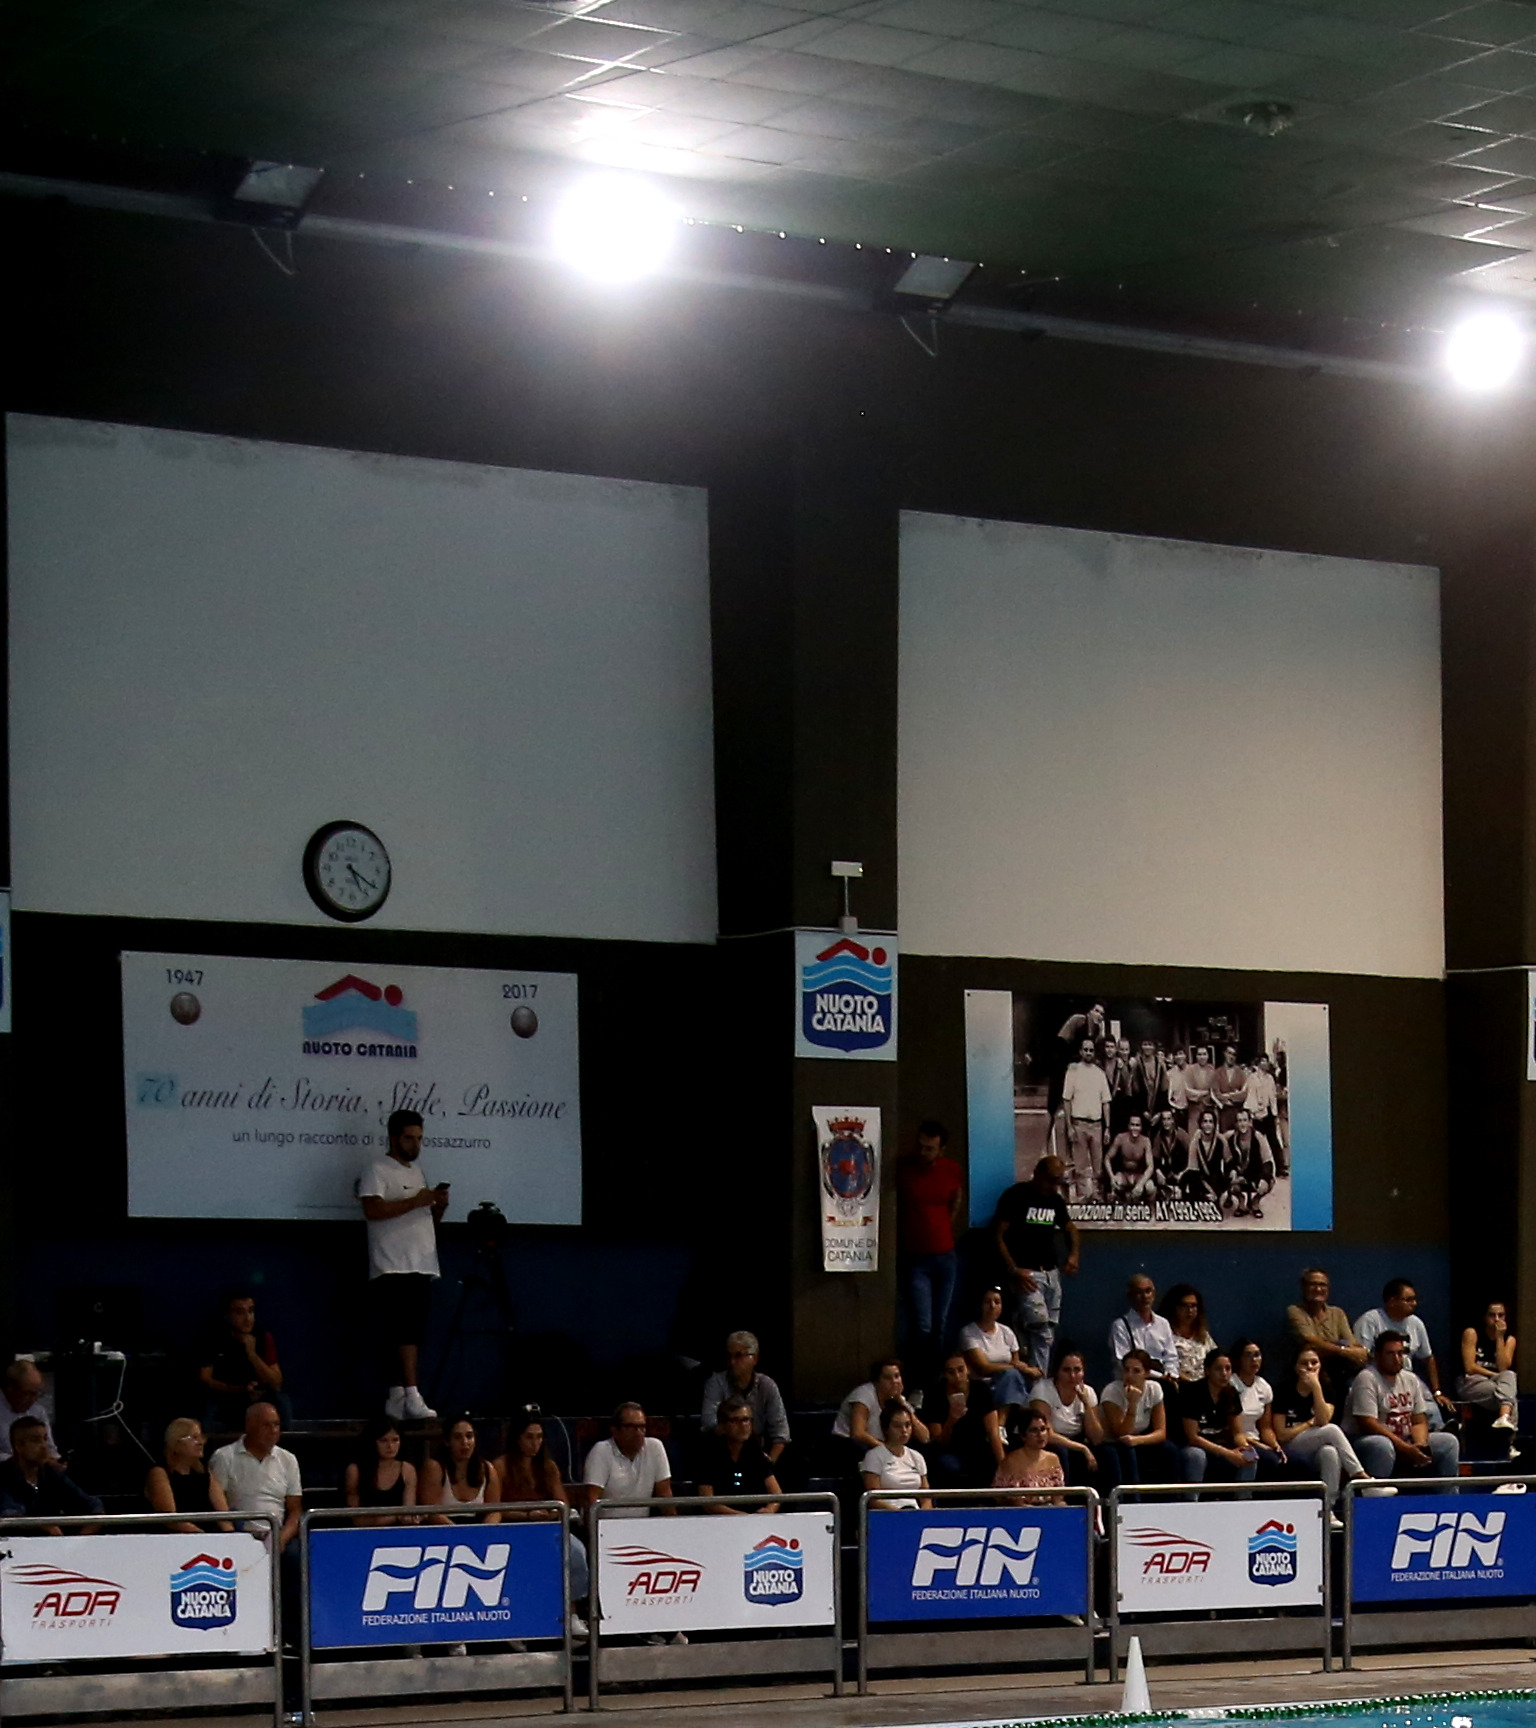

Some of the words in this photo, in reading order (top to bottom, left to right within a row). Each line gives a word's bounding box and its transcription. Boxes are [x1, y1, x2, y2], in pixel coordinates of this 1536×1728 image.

[165, 969, 204, 986] 1947
[503, 984, 538, 1000] 2017
[816, 993, 879, 1014] NUOTO
[811, 1013, 885, 1034] CATANIA
[302, 1041, 353, 1055] NUOTO
[357, 1042, 418, 1058] CATANIA
[181, 1083, 243, 1109] anni
[248, 1077, 277, 1110] di
[457, 1082, 567, 1119] Passione
[233, 1131, 250, 1143] un
[254, 1129, 295, 1147] lungo
[298, 1131, 359, 1146] racconto
[361, 1133, 374, 1146] di
[422, 1136, 491, 1149] ossazzurro
[1113, 1200, 1124, 1221] in
[1125, 1201, 1151, 1221] serie
[827, 1250, 873, 1261] CATANIA
[1391, 1511, 1506, 1569] FIN
[911, 1526, 1042, 1587] FIN
[1143, 1551, 1211, 1575] ADR
[1255, 1552, 1291, 1565] NUOTO
[361, 1543, 511, 1612] FIN
[752, 1569, 795, 1583] NUOTO
[1252, 1563, 1294, 1577] CATANIA
[1391, 1571, 1441, 1582] FEDERAZIONE
[1442, 1570, 1475, 1580] ITALIANA
[1477, 1569, 1504, 1579] NUOTO
[627, 1570, 702, 1596] ADR
[749, 1581, 799, 1596] CATANIA
[1140, 1575, 1205, 1585] TRASPORTI
[180, 1590, 228, 1605] NUOTO
[624, 1596, 694, 1606] TRASPORTI
[912, 1589, 968, 1600] FEDERAZIONE
[970, 1588, 1007, 1599] ITALIANA
[1009, 1588, 1041, 1599] NUOTO
[33, 1590, 122, 1618] ADR
[176, 1603, 232, 1619] CATANIA
[30, 1618, 112, 1630] TRASPORTI
[362, 1612, 429, 1626] FEDERAZIONE
[431, 1611, 475, 1623] ITALIANA
[477, 1609, 511, 1622] NUOTO
